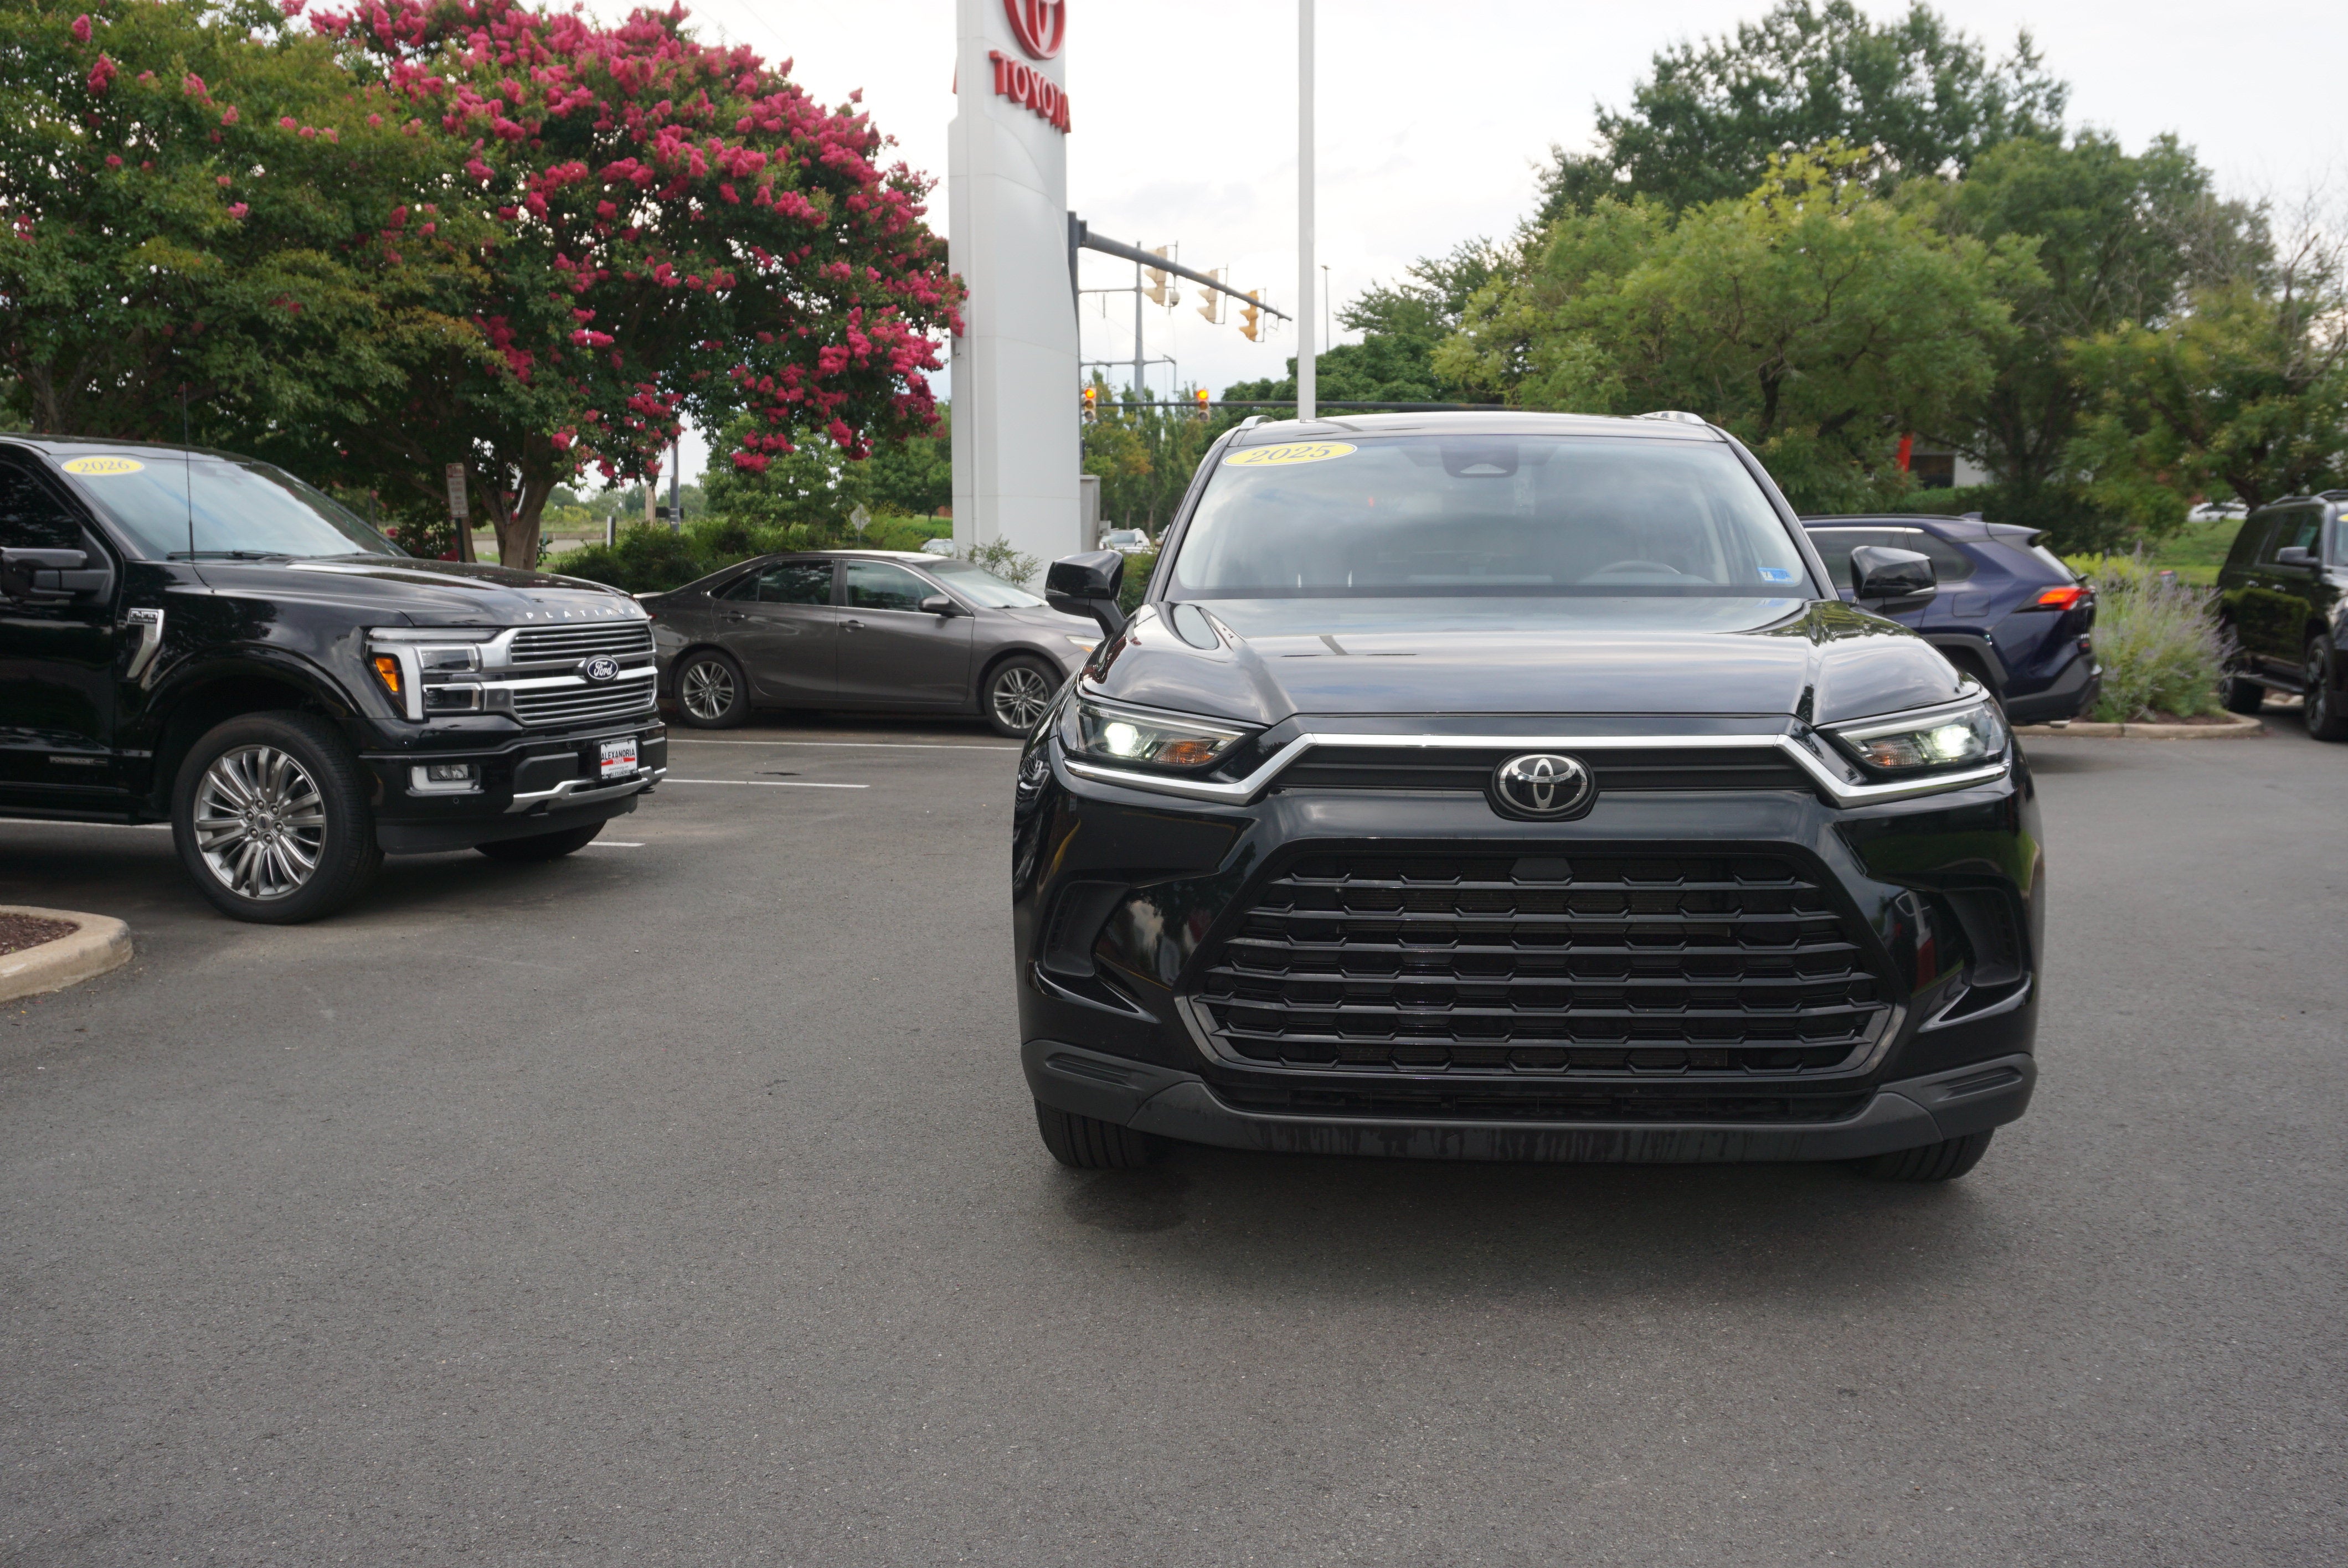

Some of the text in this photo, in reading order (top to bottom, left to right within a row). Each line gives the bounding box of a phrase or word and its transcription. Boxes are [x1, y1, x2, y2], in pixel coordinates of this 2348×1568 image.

[1244, 445, 1336, 463] 2025
[78, 460, 130, 472] 2026
[526, 607, 636, 619] PLATINUM
[594, 661, 612, 677] Ford
[601, 748, 635, 760] ALEXANDRIA
